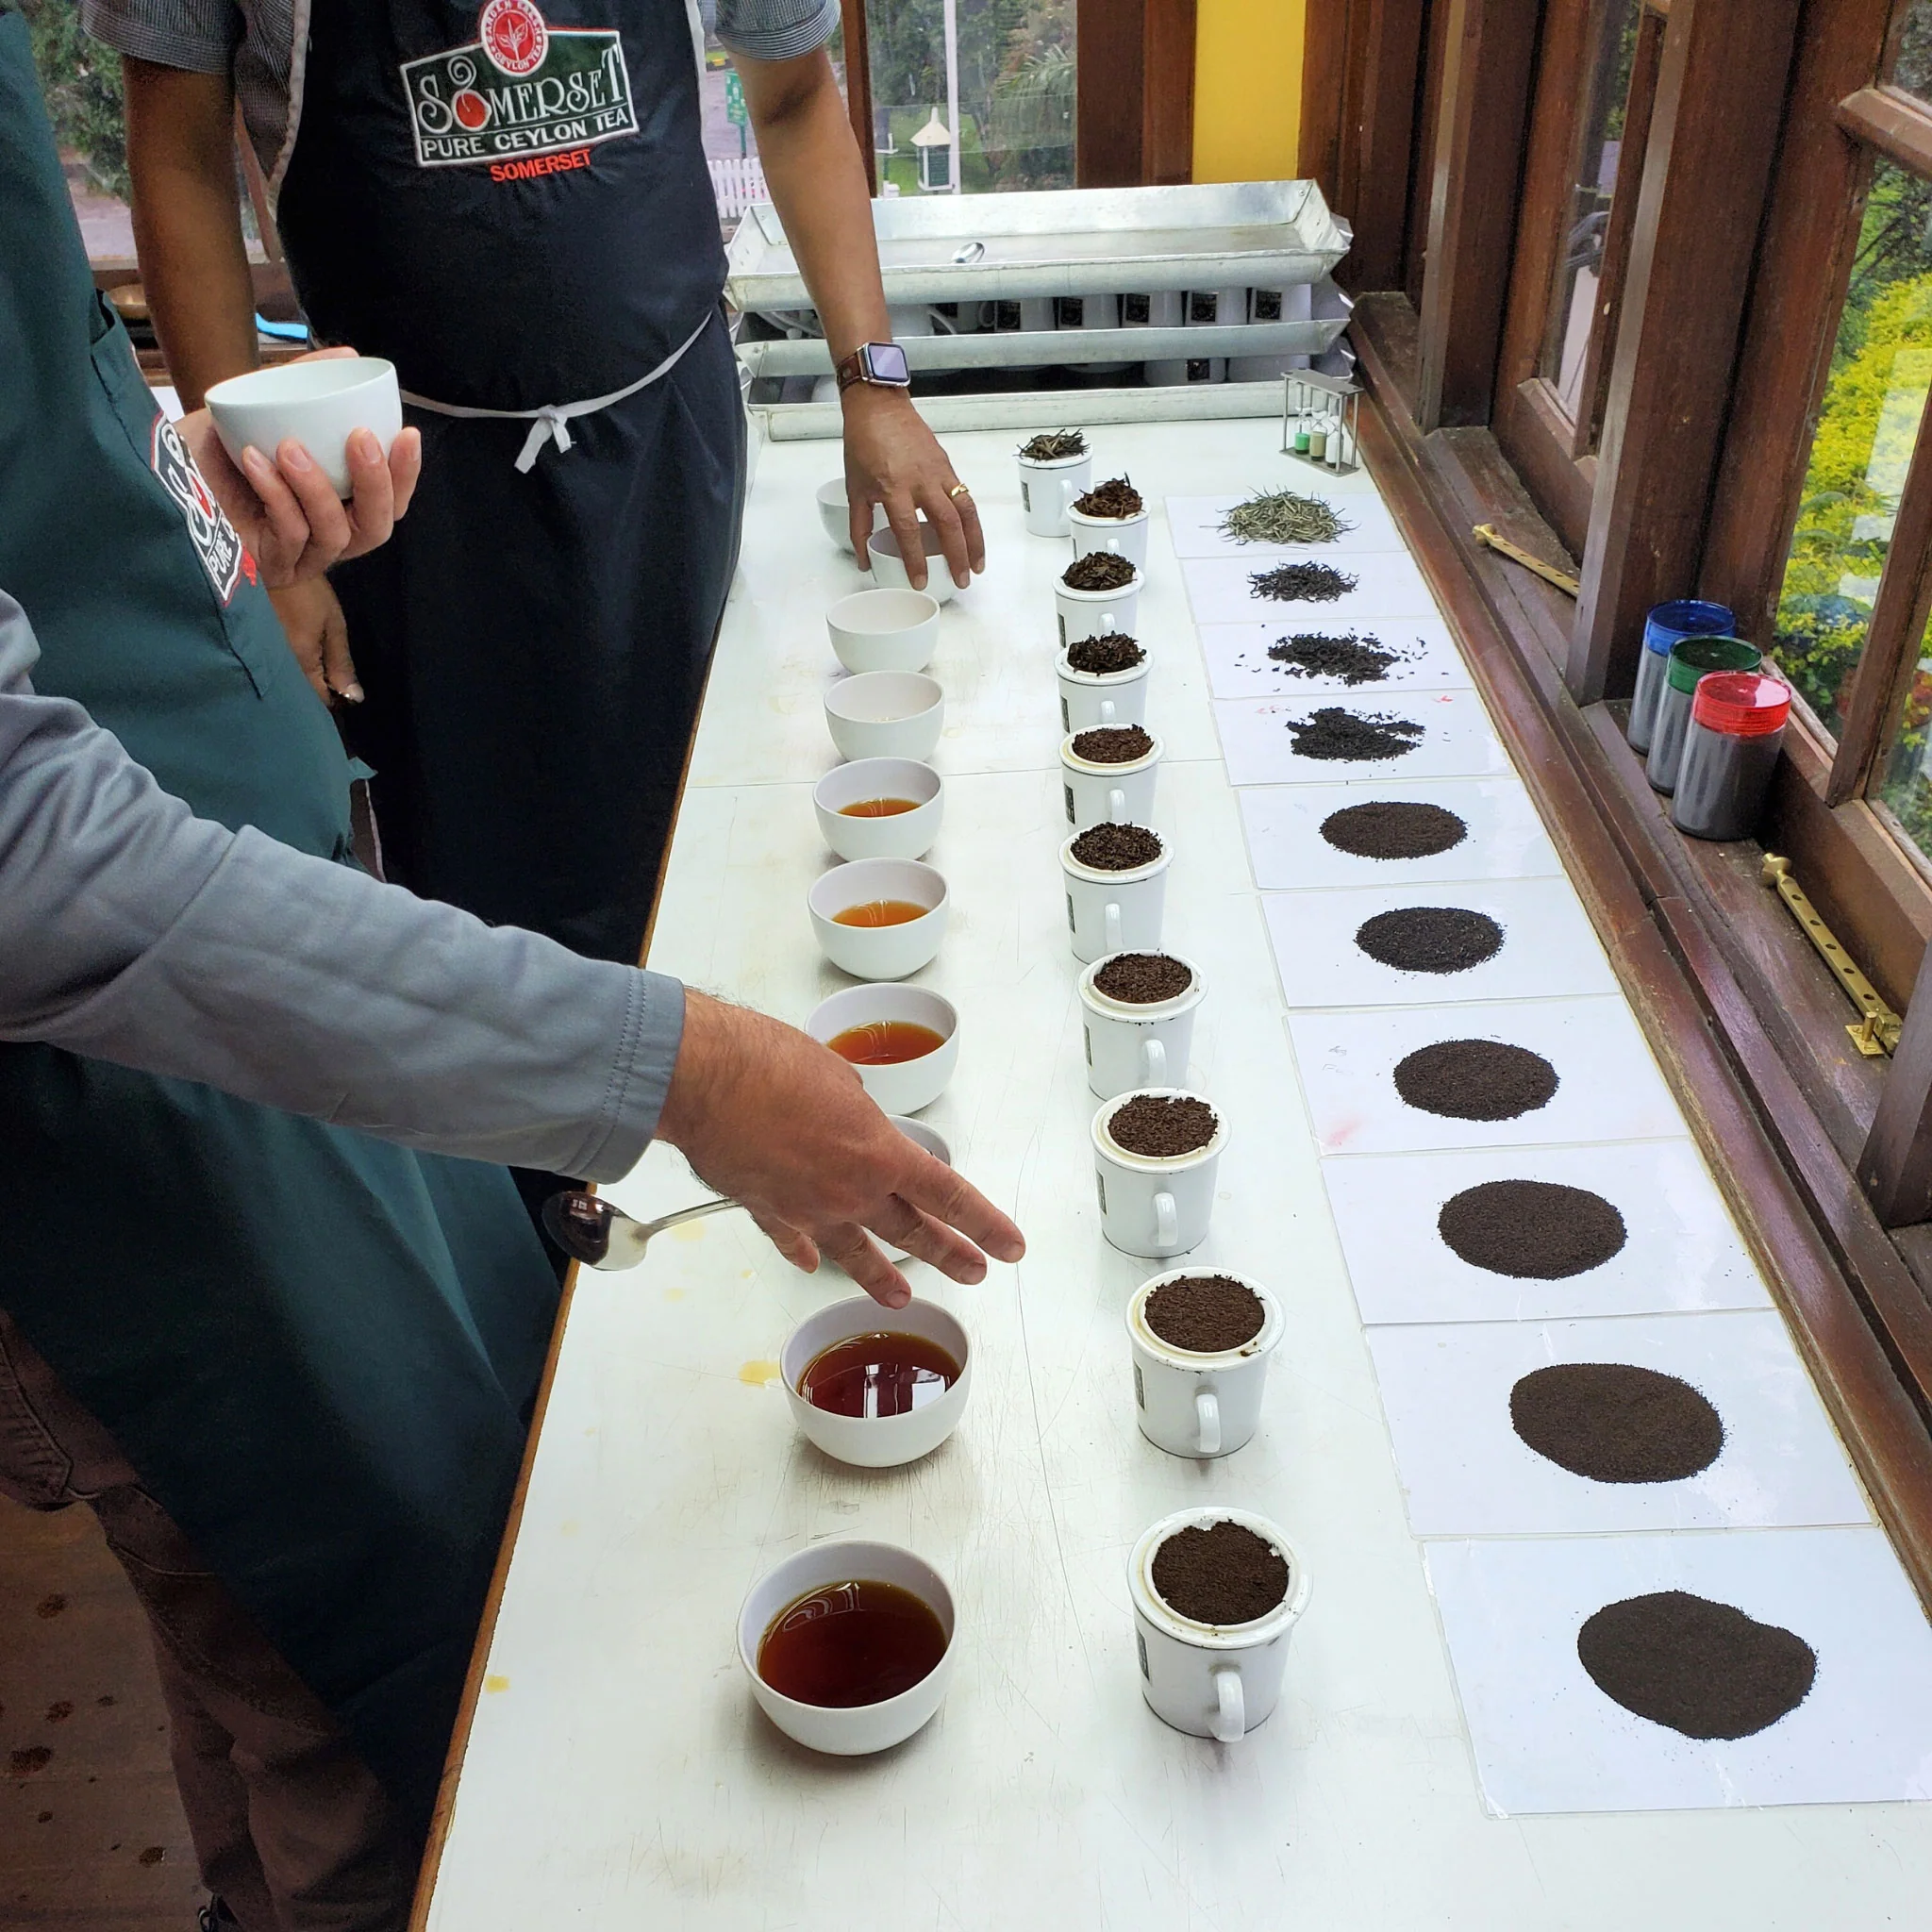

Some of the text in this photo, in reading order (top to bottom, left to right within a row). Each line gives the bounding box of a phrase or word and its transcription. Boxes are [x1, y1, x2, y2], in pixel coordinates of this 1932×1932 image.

[494, 44, 543, 71] CEYLON TEA
[417, 44, 625, 135] SOMERSET
[423, 108, 629, 158] PURE CEYLON TEA
[490, 148, 591, 182] SOMERSET
